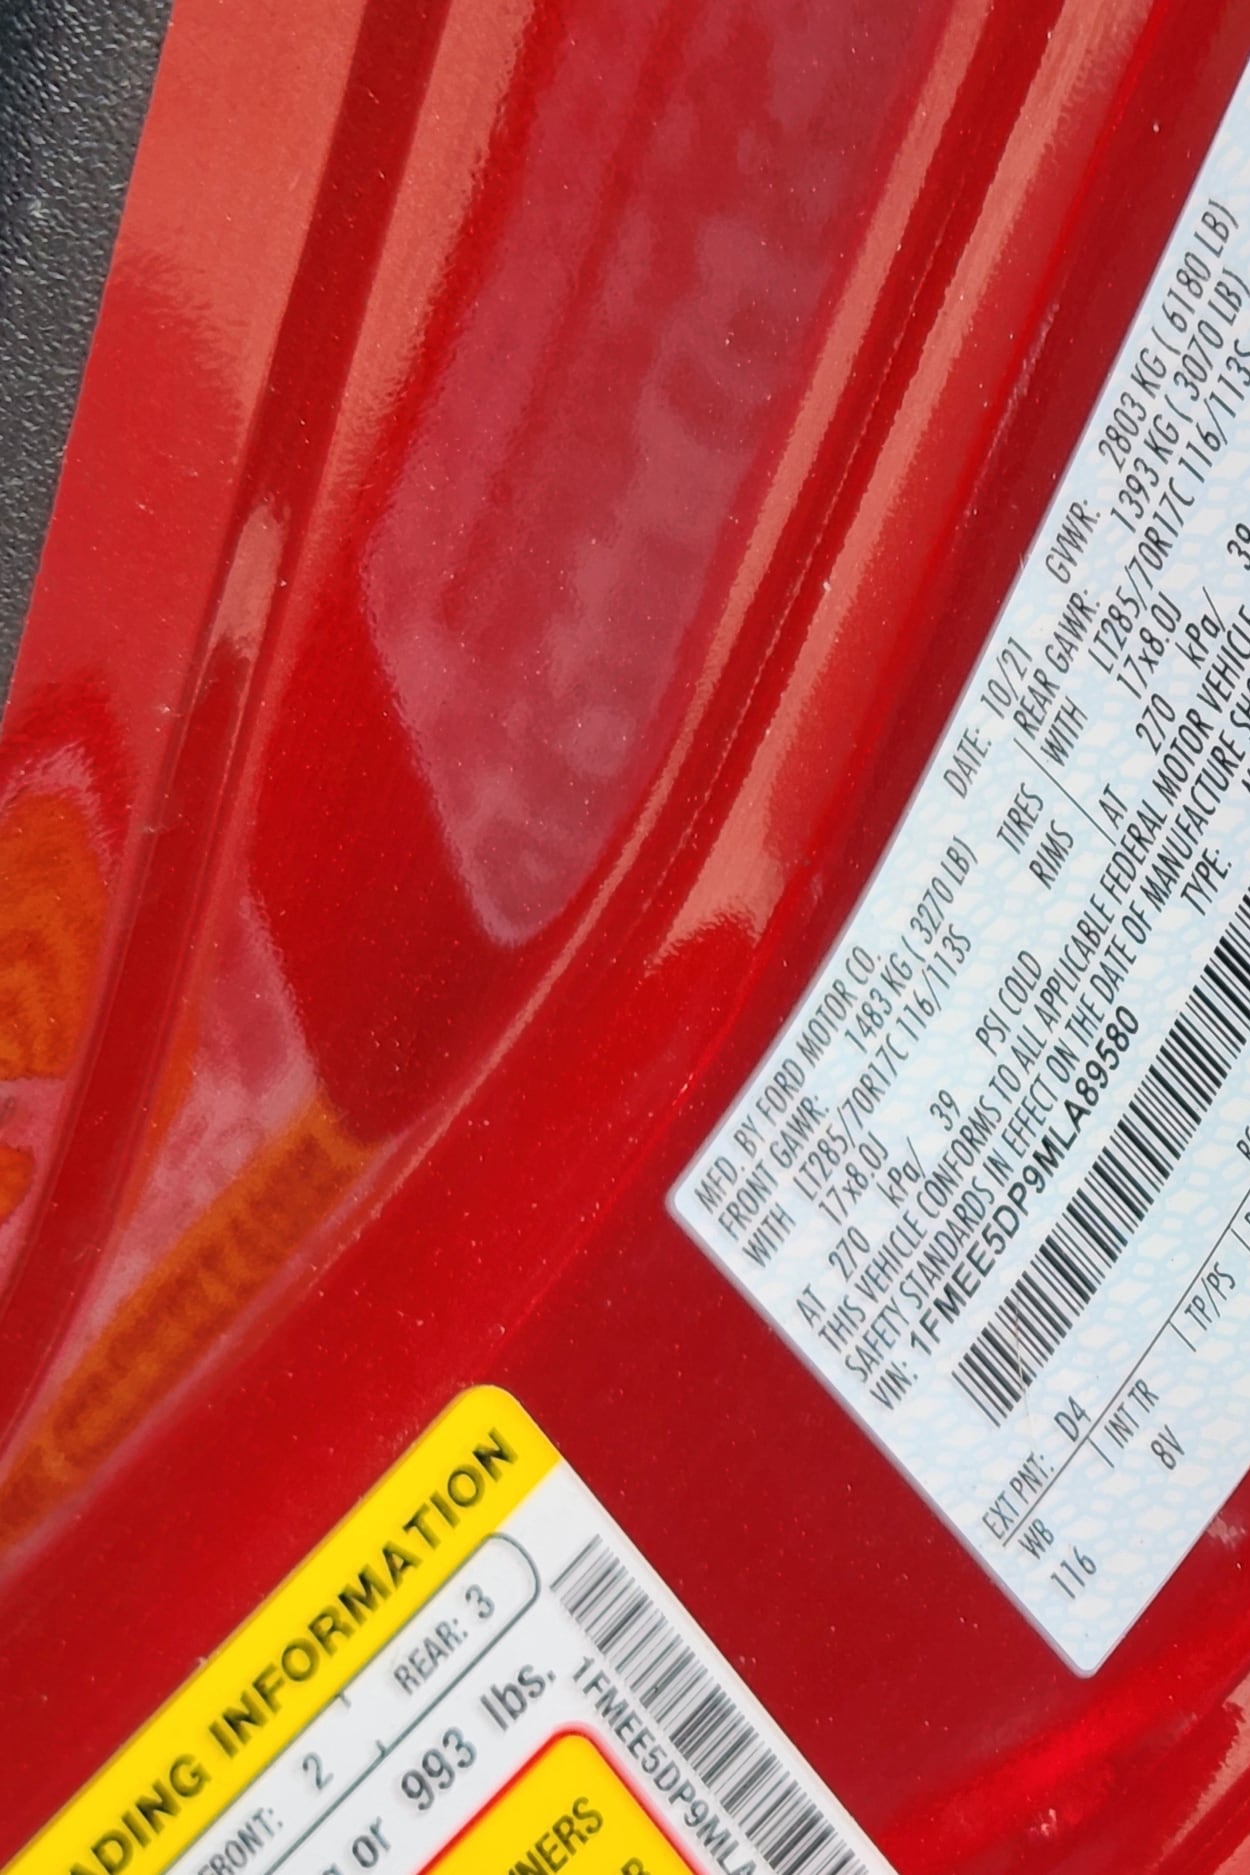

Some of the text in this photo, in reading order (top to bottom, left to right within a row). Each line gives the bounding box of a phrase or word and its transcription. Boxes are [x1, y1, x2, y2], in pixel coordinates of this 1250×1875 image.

[1045, 499, 1101, 585] GVWR:
[1097, 391, 1148, 474] 2803
[1129, 347, 1168, 400] KG
[1161, 251, 1212, 334] 6180
[1193, 198, 1239, 259] LB)
[1012, 667, 1061, 741] REAR
[1044, 589, 1101, 675] GAWR:
[1109, 456, 1160, 534] 1393
[1143, 413, 1180, 466] KG
[1172, 319, 1225, 402] 3070
[1039, 695, 1089, 767] WITH
[1087, 476, 1196, 675] LT285/70R17C
[1116, 590, 1183, 700] 17x8.0J
[942, 636, 1033, 800] DATE: 10/21
[1098, 782, 1129, 831] AT
[1135, 692, 1176, 756] 270
[1174, 585, 1227, 671] kPa/
[1179, 847, 1233, 917] TYPE:
[694, 945, 882, 1215] MFD. BY FORD MOTOR CO.
[717, 1159, 778, 1241] FRONT
[769, 1095, 830, 1169] GAWR:
[844, 987, 893, 1054] 1483
[879, 951, 913, 998] KG
[909, 876, 954, 945] 3270
[940, 835, 979, 887] LB)
[741, 781, 1044, 1268] WITH LT285/70R17C 116/113S TIRES
[795, 949, 1042, 1329] AT 270 kPa/ 39 PSI COLD
[817, 1294, 867, 1354] THIS
[853, 1209, 928, 1304] VEHICLE
[916, 1094, 1003, 1219] CONFORMS
[987, 1063, 1022, 1105] TO
[1010, 1023, 1048, 1076] ALL
[1033, 892, 1116, 1034] APPLICABLE
[1099, 798, 1169, 906] FEDERAL
[1151, 707, 1215, 808] MOTOR
[818, 818, 1074, 1226] 17x8.0J RIMS
[844, 1295, 910, 1384] SAFETY
[898, 1175, 996, 1311] STANDARDS
[981, 1147, 1015, 1188] IN
[1000, 1072, 1059, 1159] EFFECT
[1045, 1036, 1081, 1085] ON
[1063, 991, 1106, 1049] THE
[1089, 933, 1138, 1006] DATE
[1121, 899, 1153, 945] OF
[1139, 728, 1247, 914] MANUFACTURE
[869, 1005, 1140, 1411] VIN: 1FMEE5DP9MLA89580
[1183, 1261, 1236, 1332] TP/PS
[981, 1395, 1092, 1541] EXT PNT: D4
[1103, 1378, 1160, 1450] INT TR
[1150, 1423, 1185, 1471] 8V
[208, 1428, 520, 1759] INFORMATION
[393, 1583, 496, 1696] REAR: 3
[1017, 1518, 1055, 1560] WB
[1050, 1546, 1097, 1600] 116
[302, 1751, 334, 1790] 2
[352, 1663, 557, 1868] or 993 lbs.
